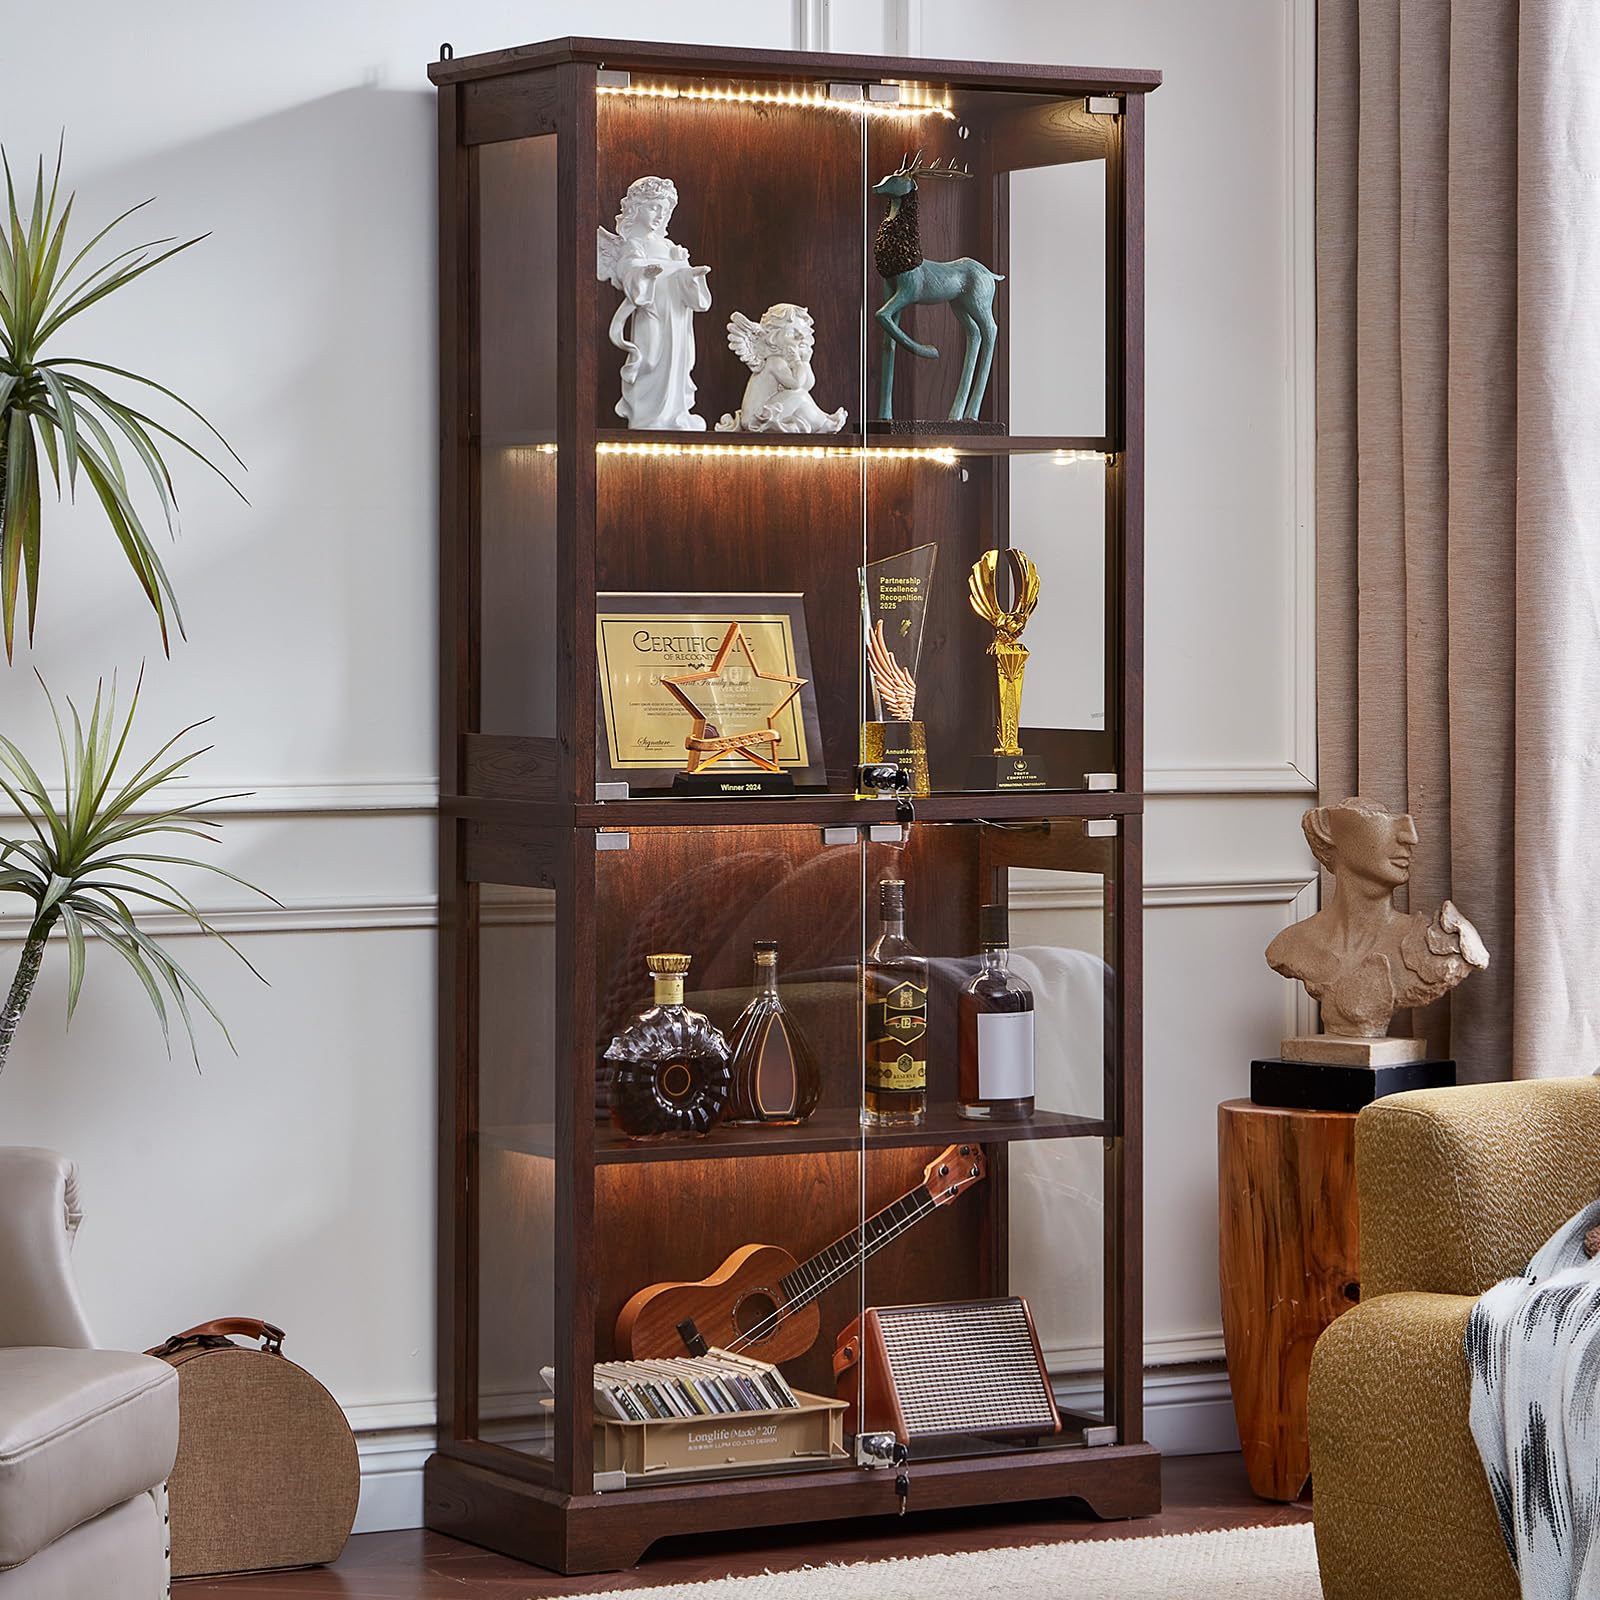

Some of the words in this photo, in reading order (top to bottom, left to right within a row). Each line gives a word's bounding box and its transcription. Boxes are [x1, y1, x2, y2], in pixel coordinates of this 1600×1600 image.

[880, 577, 921, 585] Partnership
[880, 594, 923, 602] Recognition
[720, 783, 745, 791] Winner
[745, 783, 762, 791] 2024
[902, 1018, 910, 1027] 12
[688, 1429, 730, 1444] Longlife
[762, 1425, 777, 1436] 207
